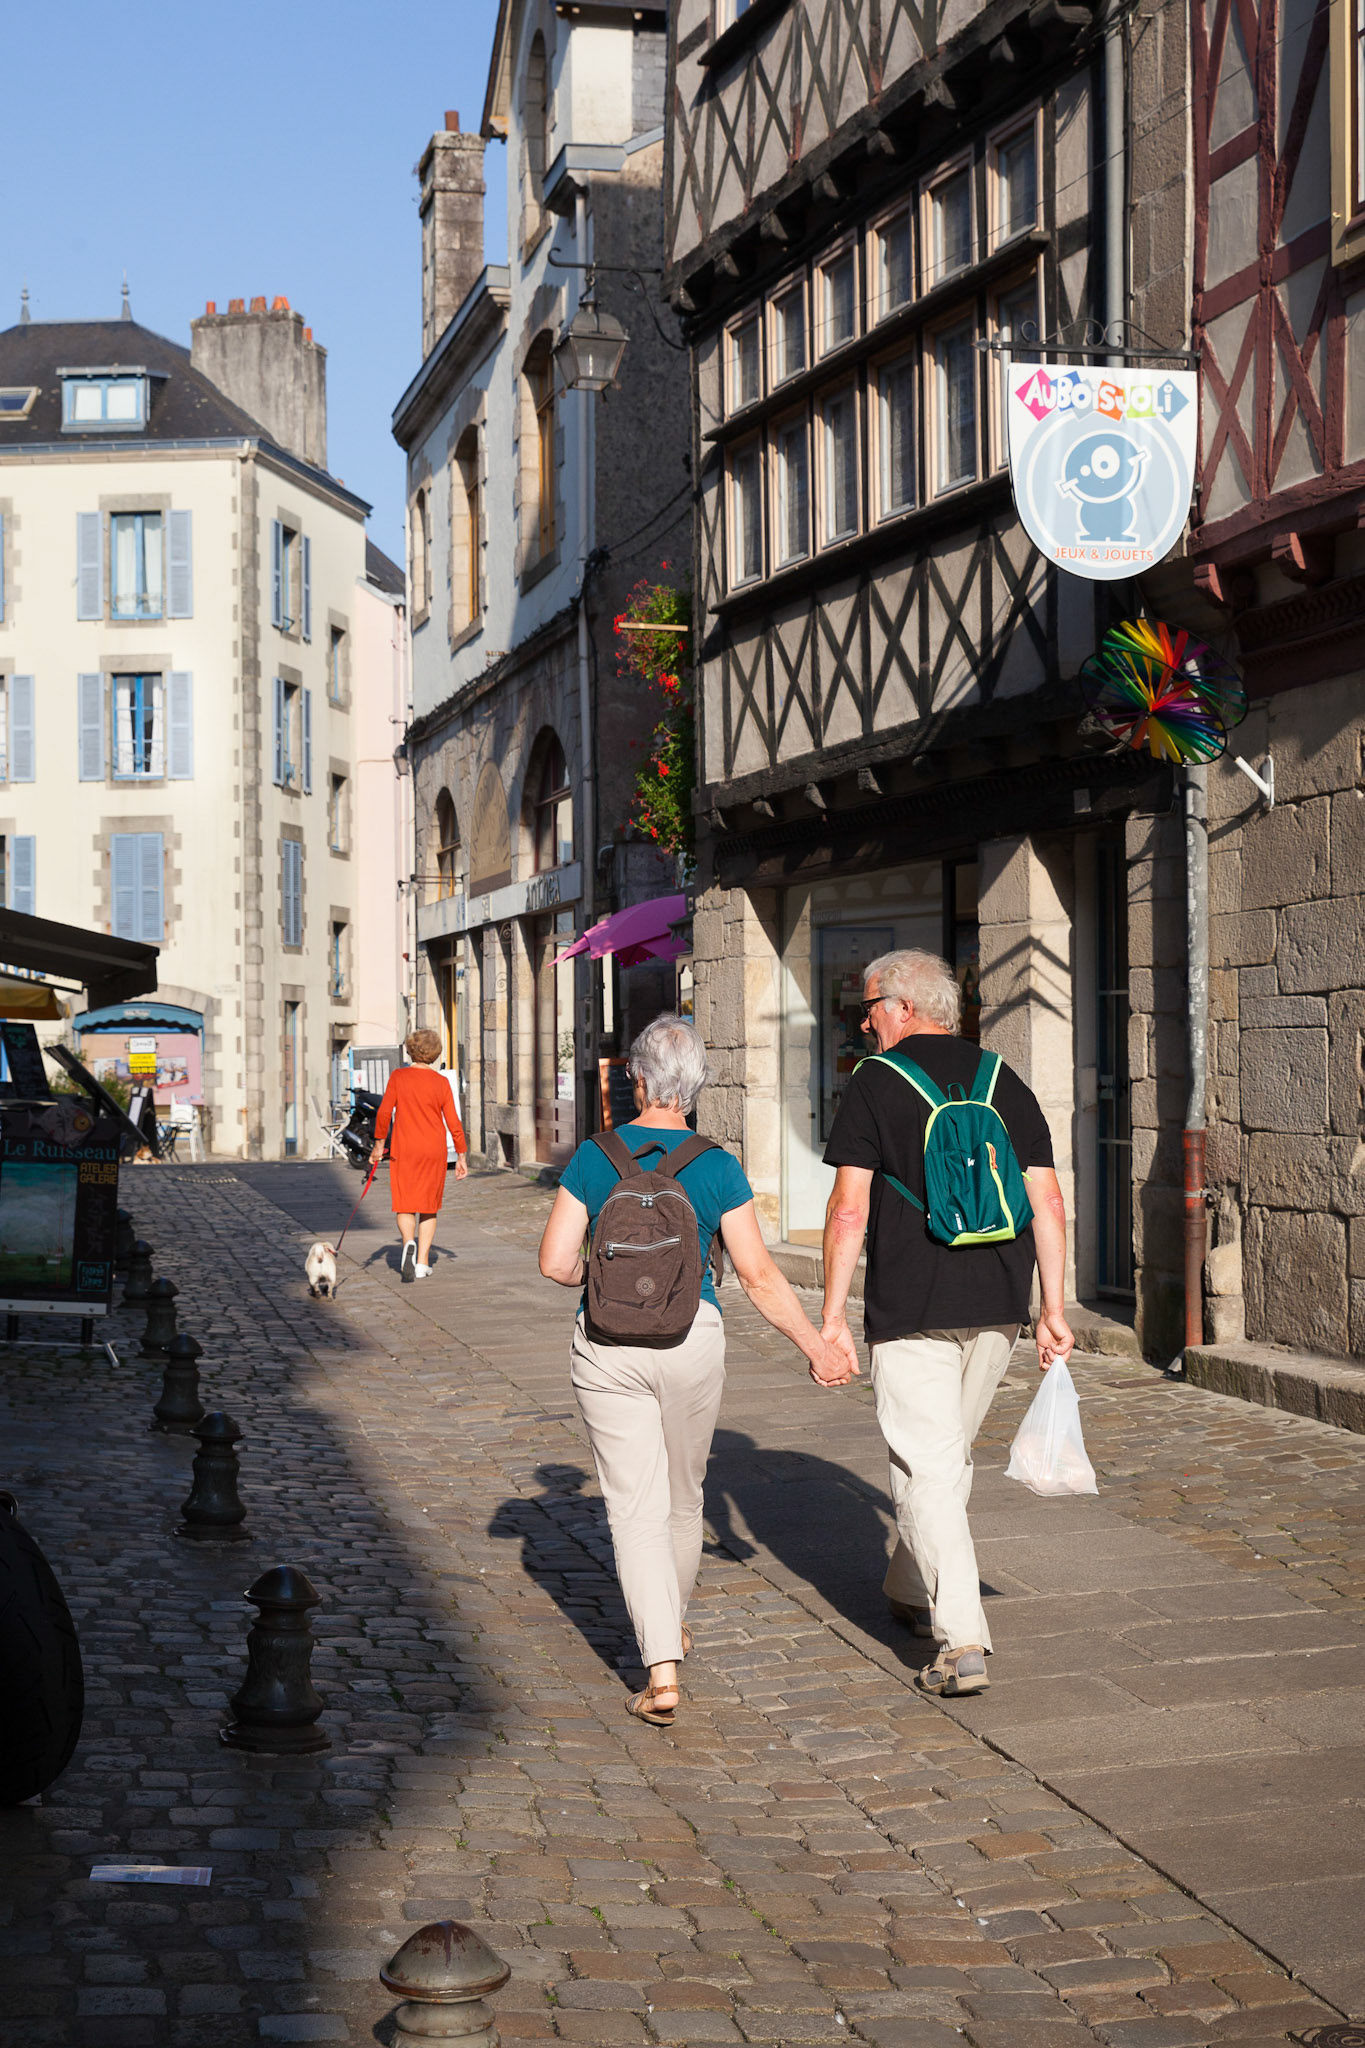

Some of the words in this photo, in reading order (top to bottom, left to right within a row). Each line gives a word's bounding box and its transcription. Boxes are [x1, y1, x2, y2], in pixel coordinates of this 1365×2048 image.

[1055, 547, 1086, 560] JEUX
[1090, 548, 1100, 560] &
[1104, 547, 1154, 562] JOUETS
[3, 1139, 26, 1157] Le
[33, 1140, 117, 1161] Ruisseau
[80, 1162, 118, 1174] ATELIER
[80, 1173, 118, 1185] GALERIE
